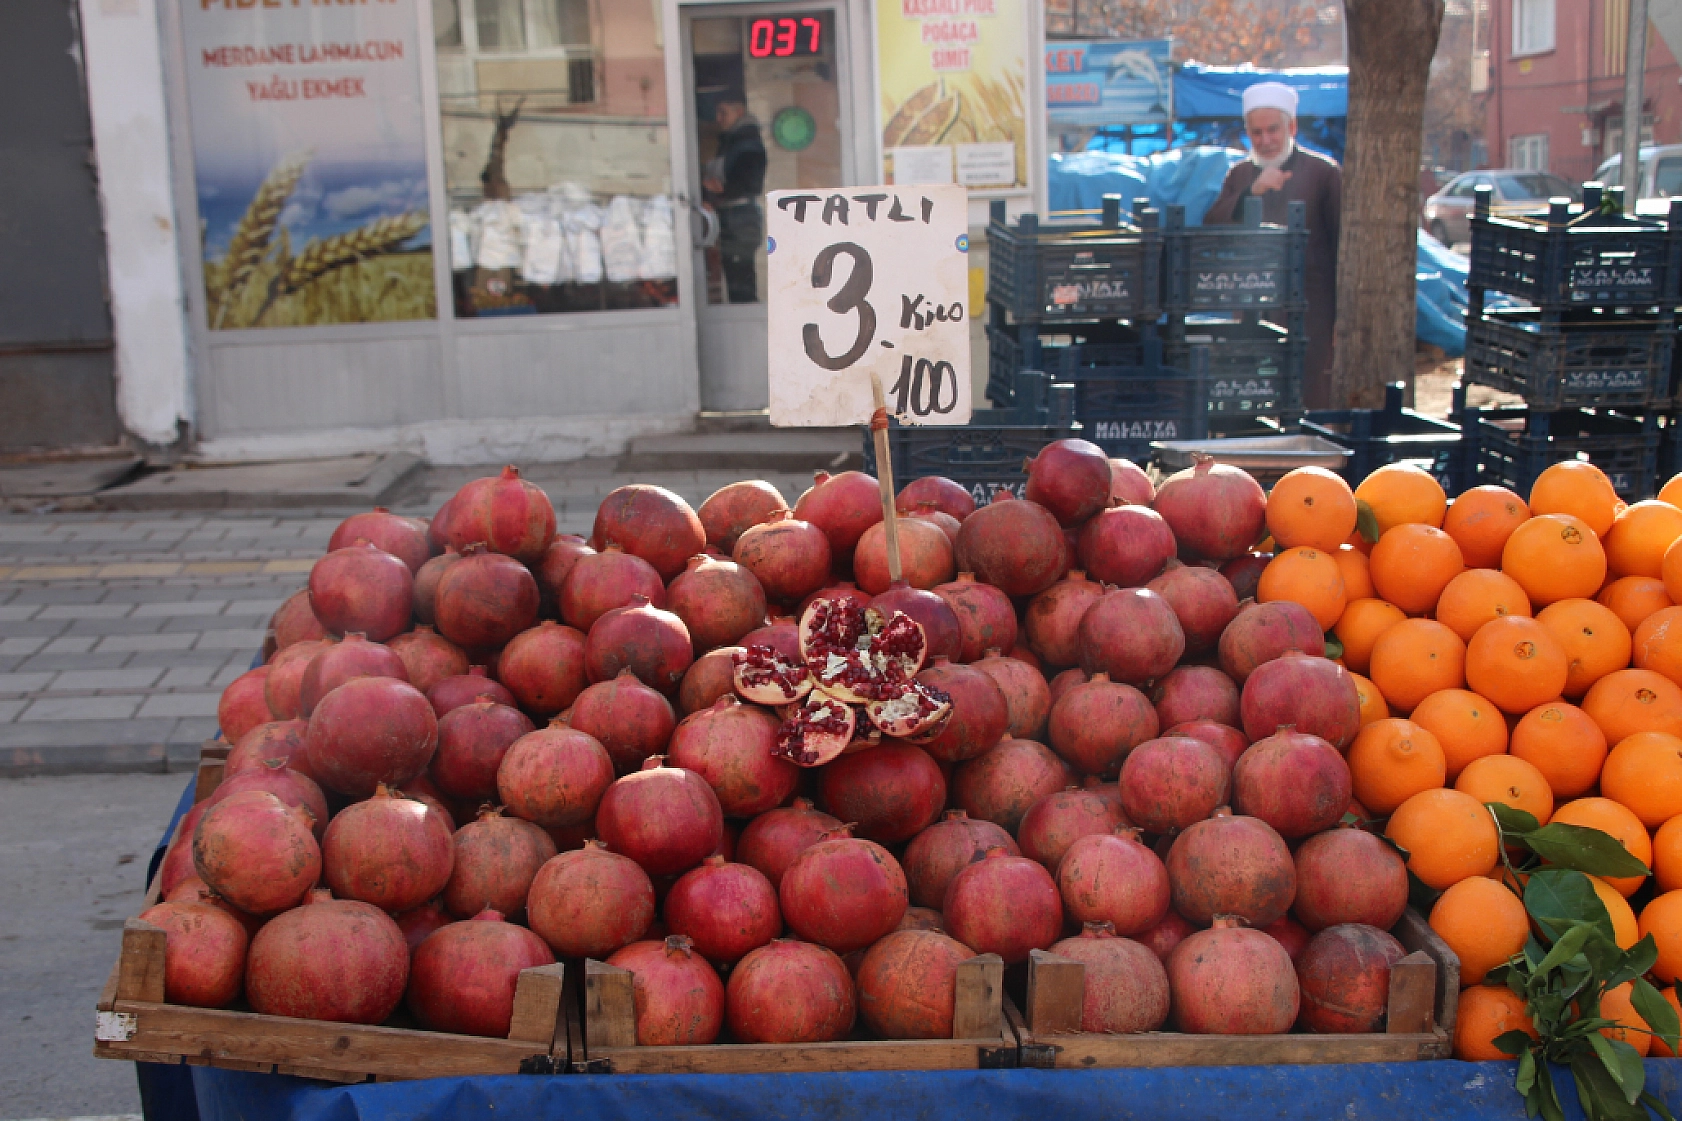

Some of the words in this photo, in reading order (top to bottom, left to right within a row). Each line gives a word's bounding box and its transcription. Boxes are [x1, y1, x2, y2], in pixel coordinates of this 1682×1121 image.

[750, 17, 821, 57] 037
[203, 44, 294, 67] MERDANE
[299, 41, 404, 64] LAHMACUN
[303, 77, 366, 98] EKMEK
[778, 193, 934, 226] TATLI
